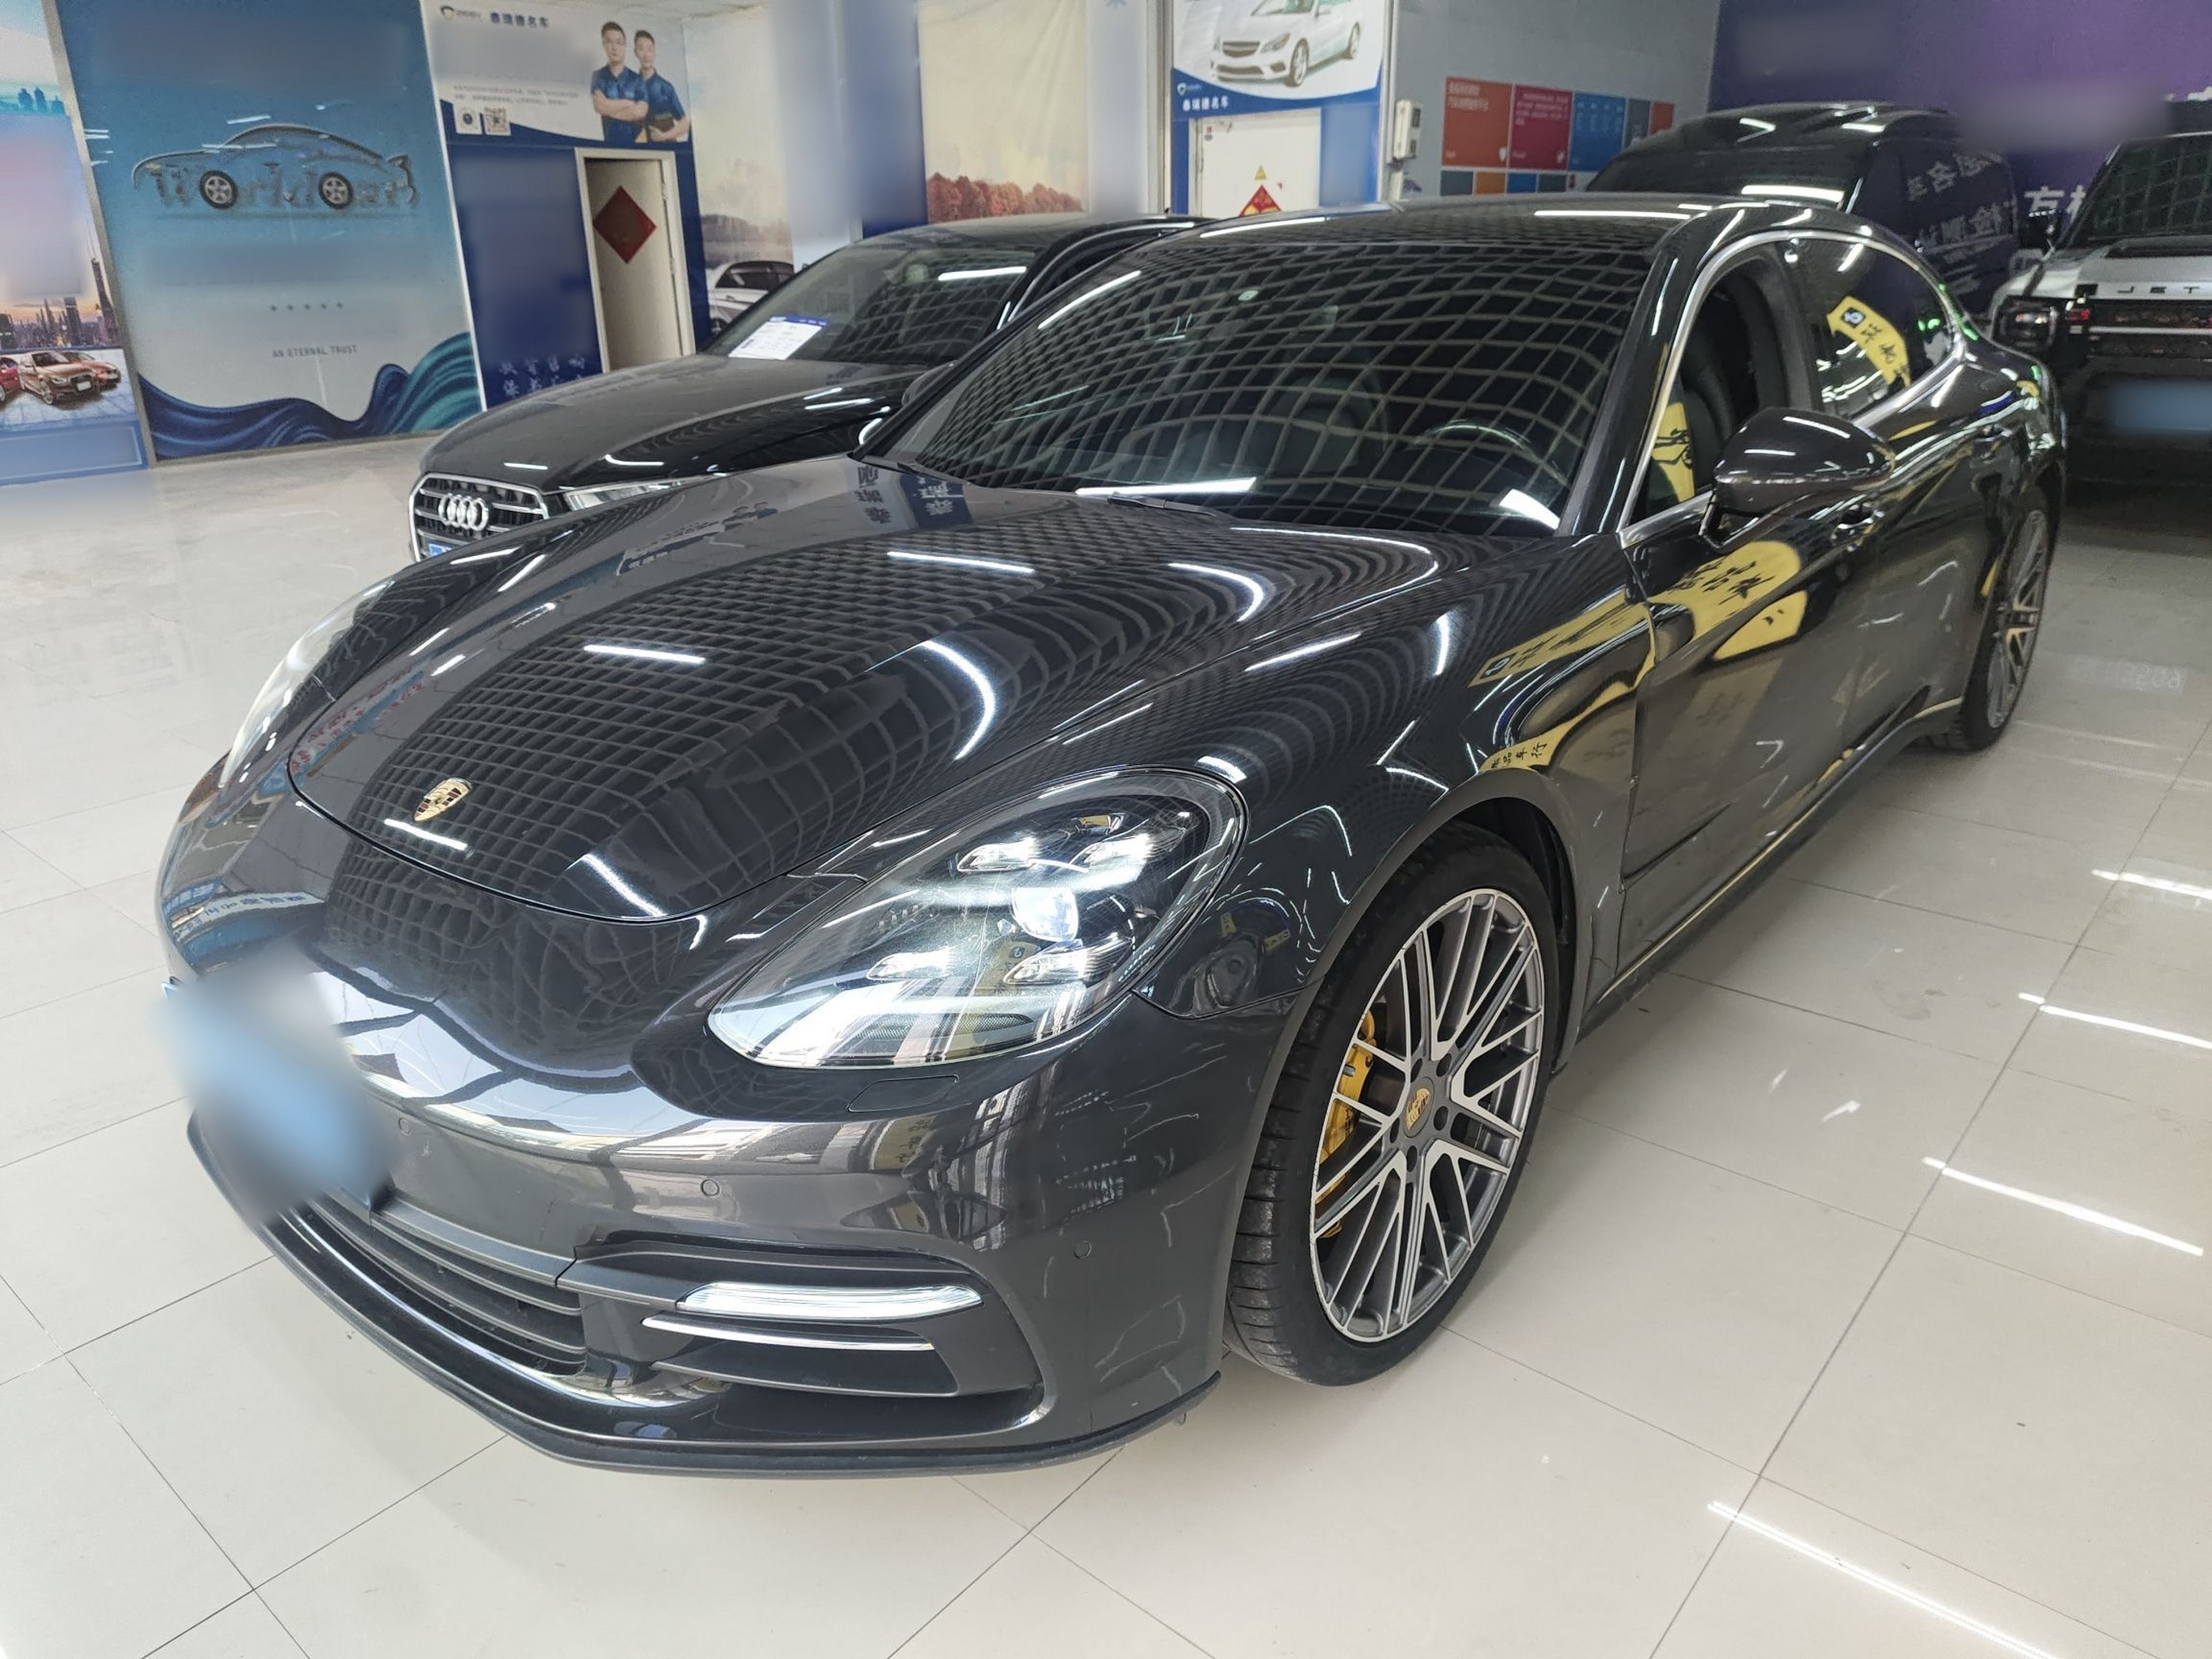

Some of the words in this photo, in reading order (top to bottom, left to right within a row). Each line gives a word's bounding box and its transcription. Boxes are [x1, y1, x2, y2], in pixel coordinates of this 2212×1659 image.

[2116, 285, 2200, 294] JET
[287, 347, 327, 357] ETERNAL
[329, 344, 357, 354] TRUST
